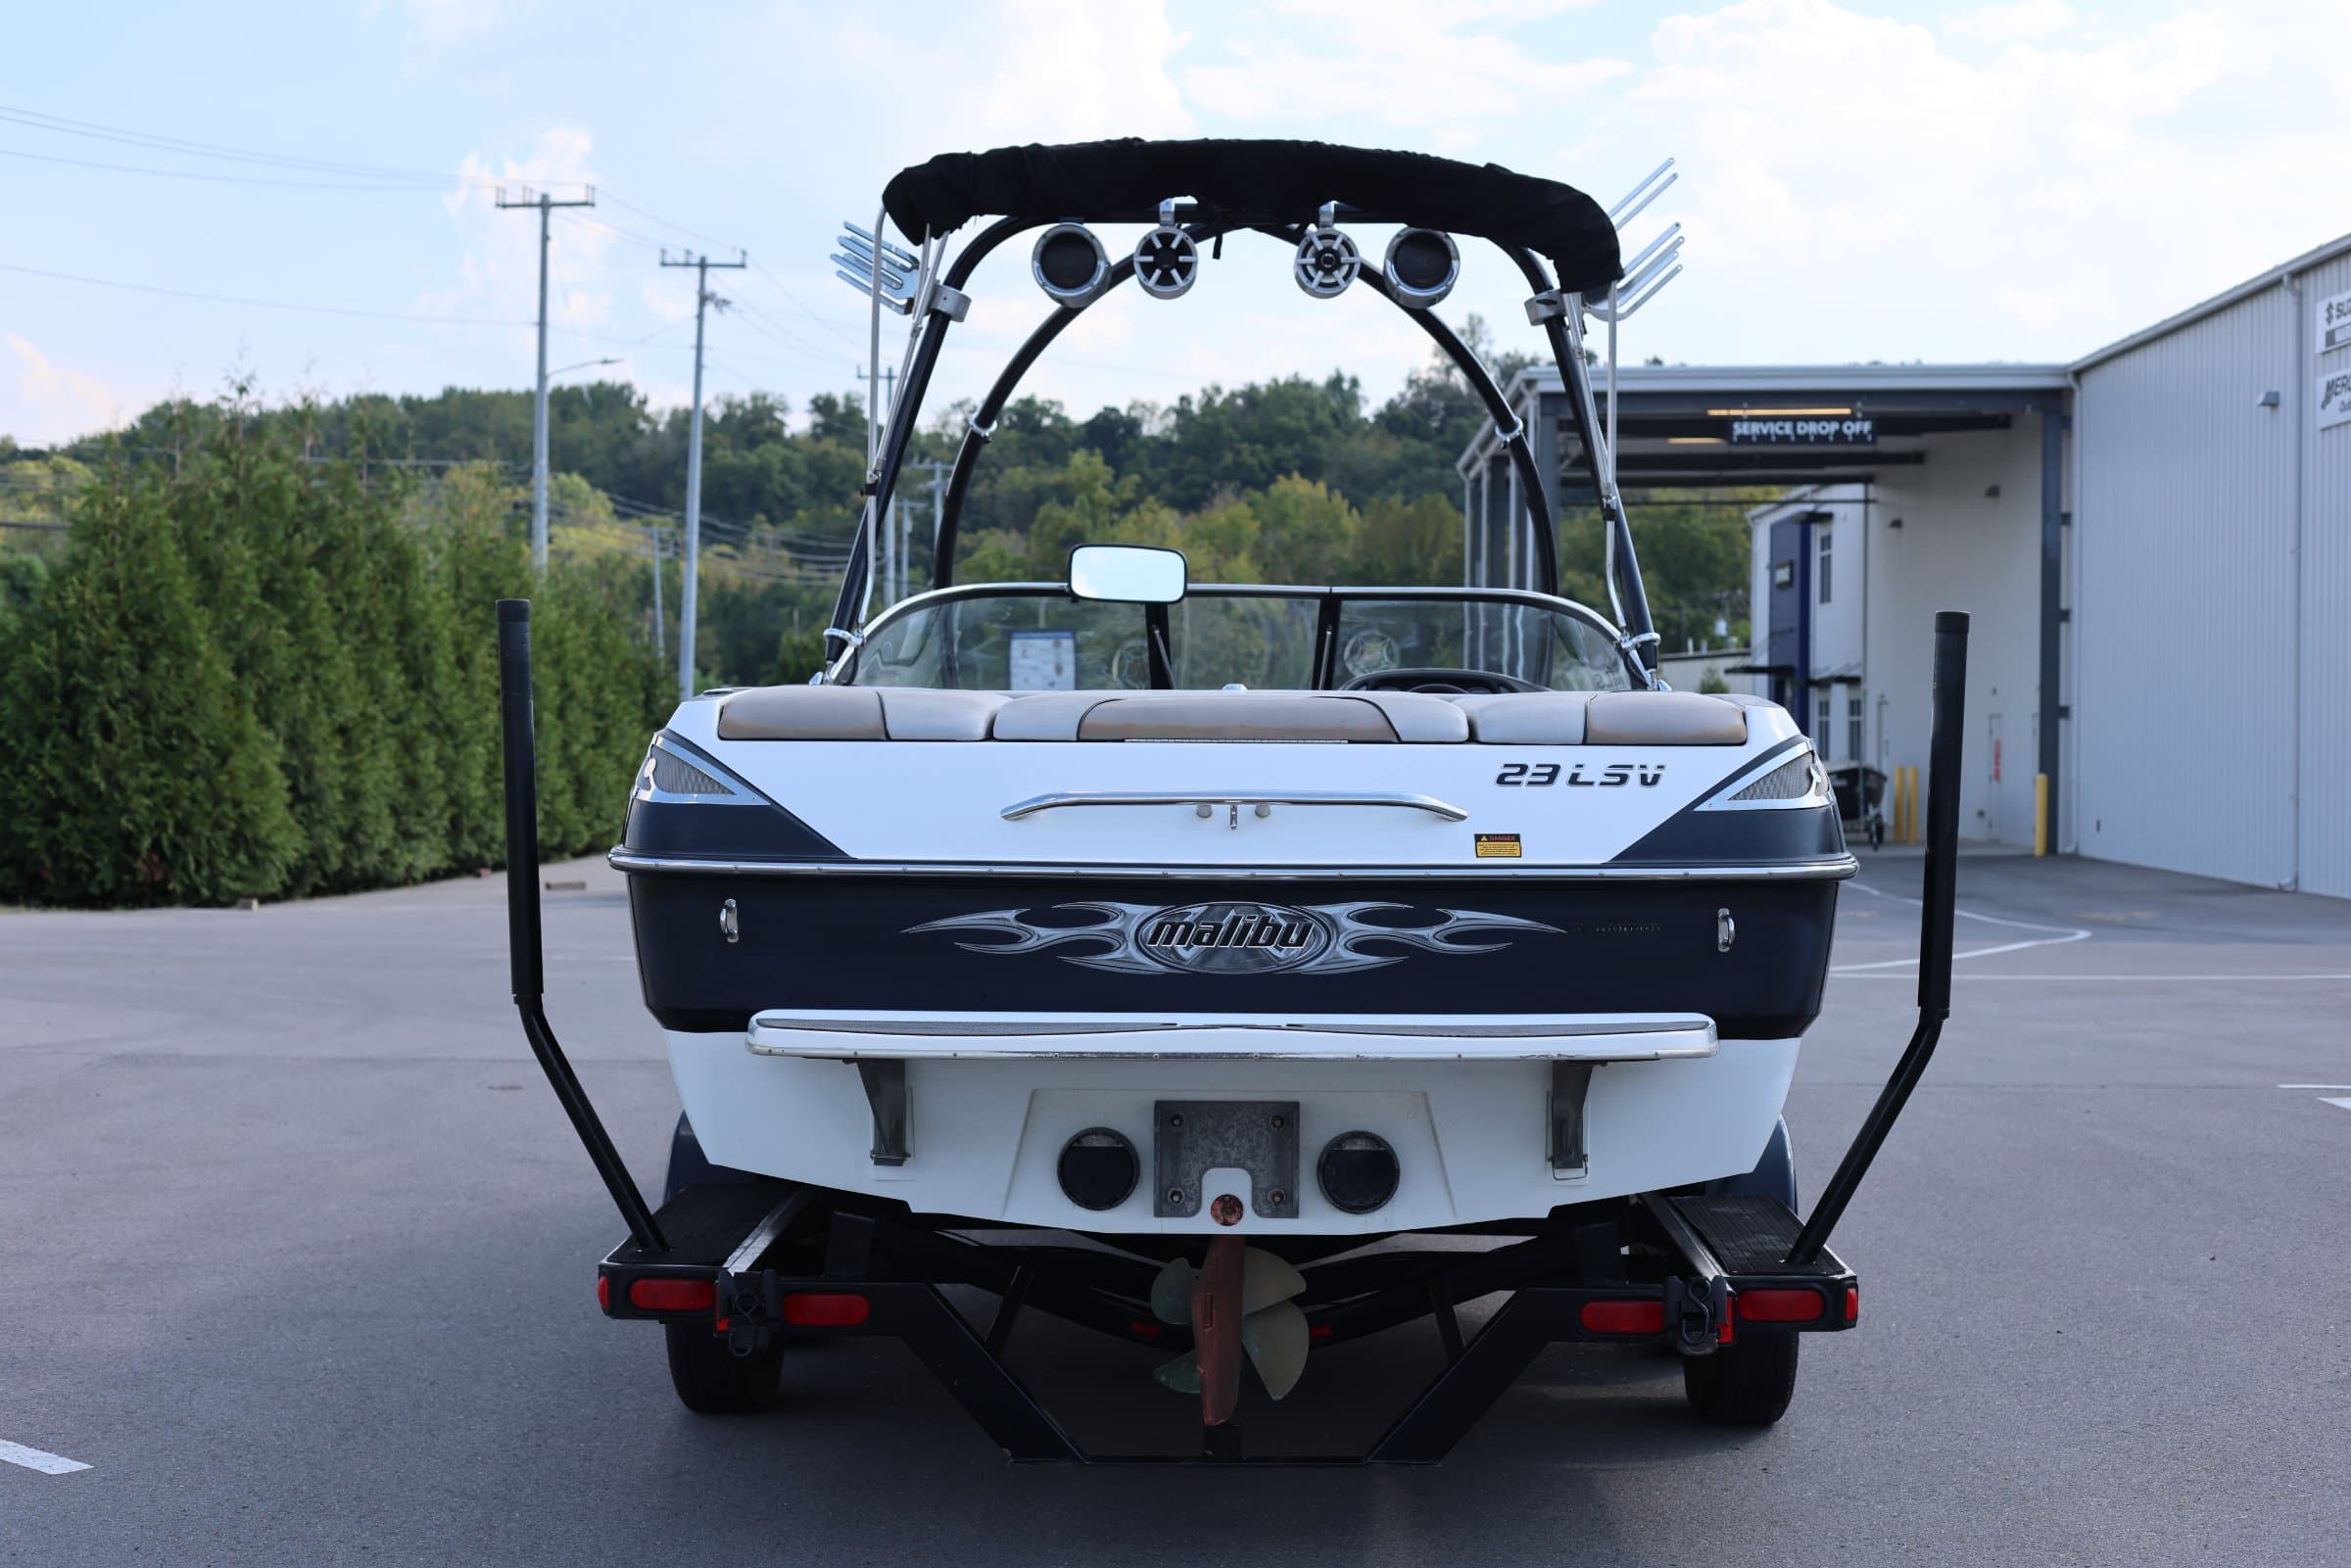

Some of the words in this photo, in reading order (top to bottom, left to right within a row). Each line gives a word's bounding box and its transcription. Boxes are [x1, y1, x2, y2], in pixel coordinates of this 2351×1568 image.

[1732, 421, 1794, 435] SERVICE
[1796, 421, 1840, 435] DROP
[1842, 420, 1872, 435] OFF
[1146, 915, 1315, 948] malibu
